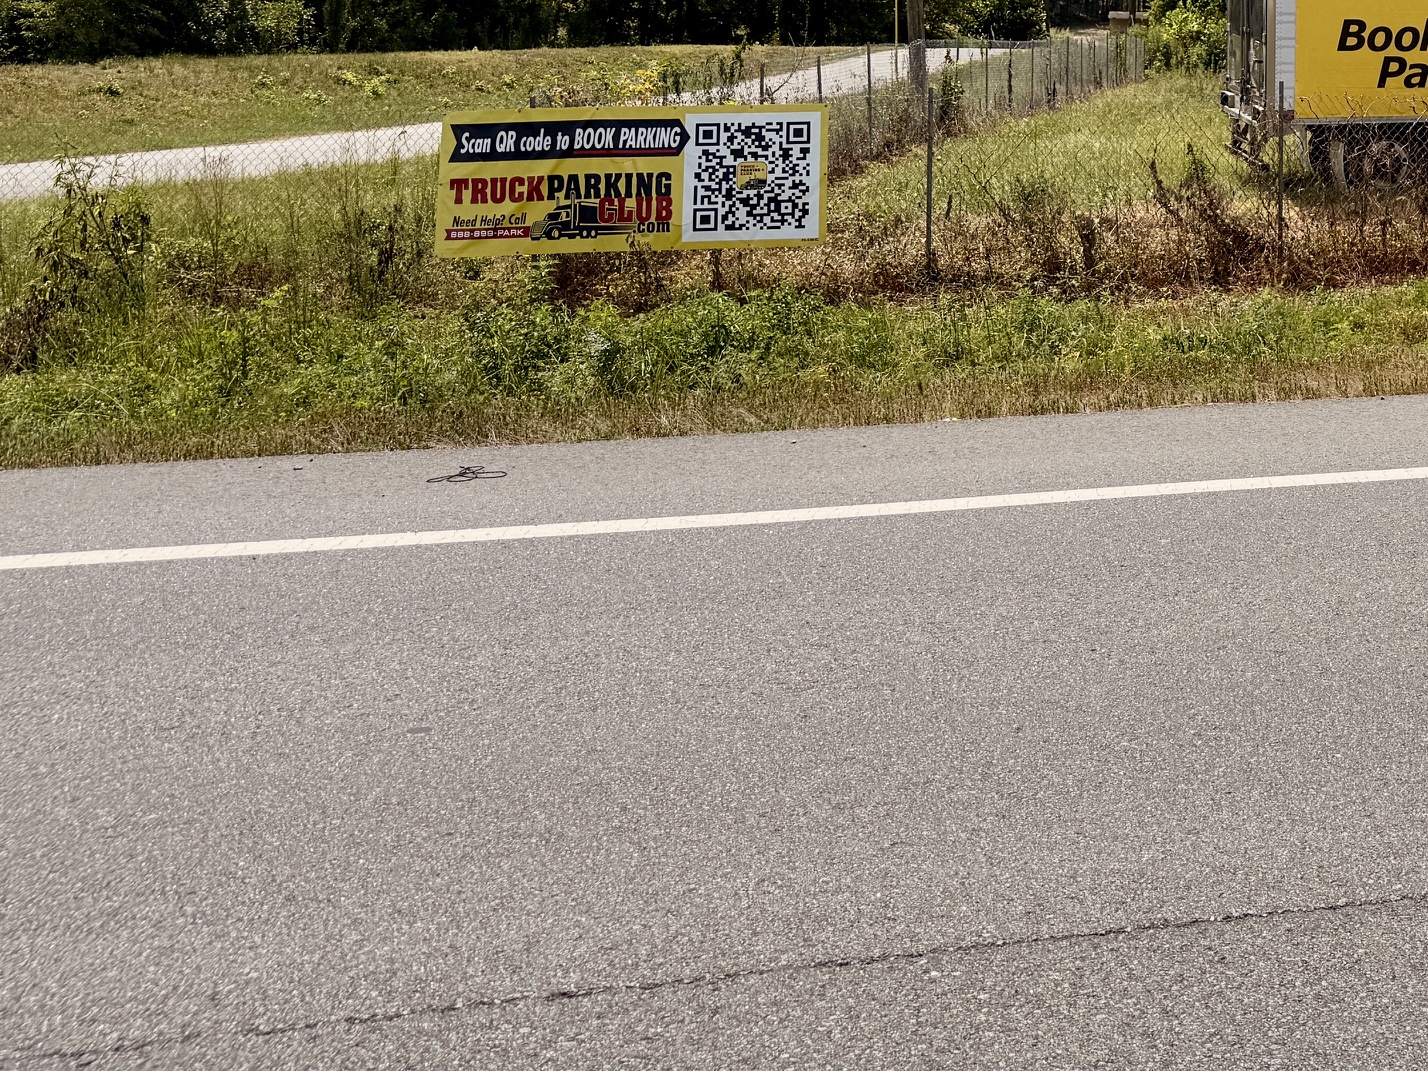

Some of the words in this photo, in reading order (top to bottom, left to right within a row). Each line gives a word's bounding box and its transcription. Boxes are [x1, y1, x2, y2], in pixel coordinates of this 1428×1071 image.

[460, 132, 492, 154] Scan
[495, 130, 517, 153] QR
[520, 128, 552, 152] code
[556, 131, 570, 150] to
[573, 127, 616, 149] BOOK
[618, 127, 681, 148] PARKING
[452, 214, 478, 228] Need
[480, 213, 506, 228] Help?
[508, 212, 527, 225] Call
[597, 195, 673, 224] CLUB
